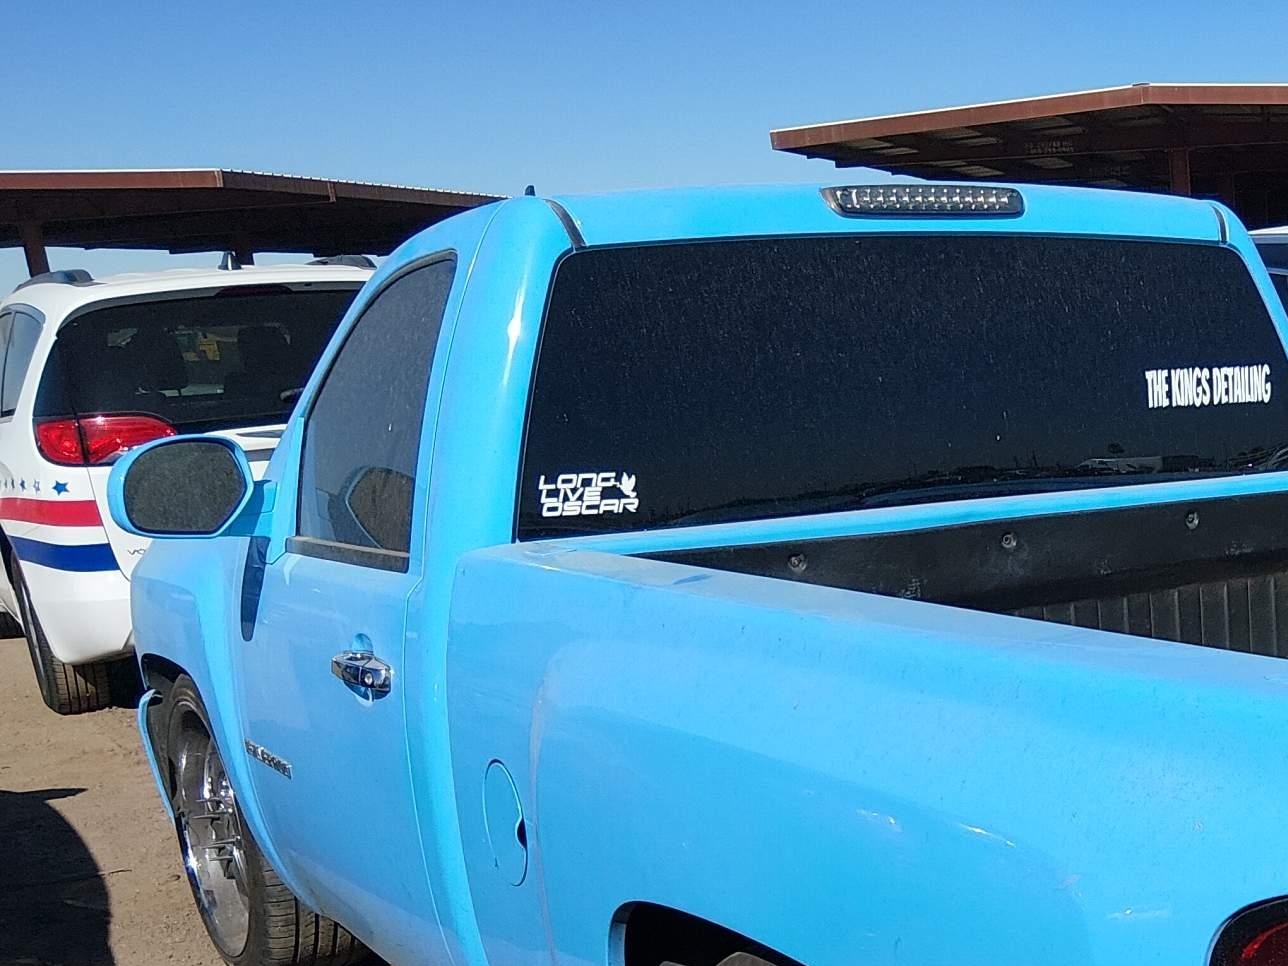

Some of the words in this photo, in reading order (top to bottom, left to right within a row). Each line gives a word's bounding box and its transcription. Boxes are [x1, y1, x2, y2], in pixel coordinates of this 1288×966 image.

[1144, 369, 1170, 409] THE
[1170, 366, 1211, 408] KINGS
[1212, 363, 1272, 406] DETAILING
[539, 472, 617, 490] LONG
[540, 487, 603, 504] LIVE
[542, 498, 639, 518] OSCAR
